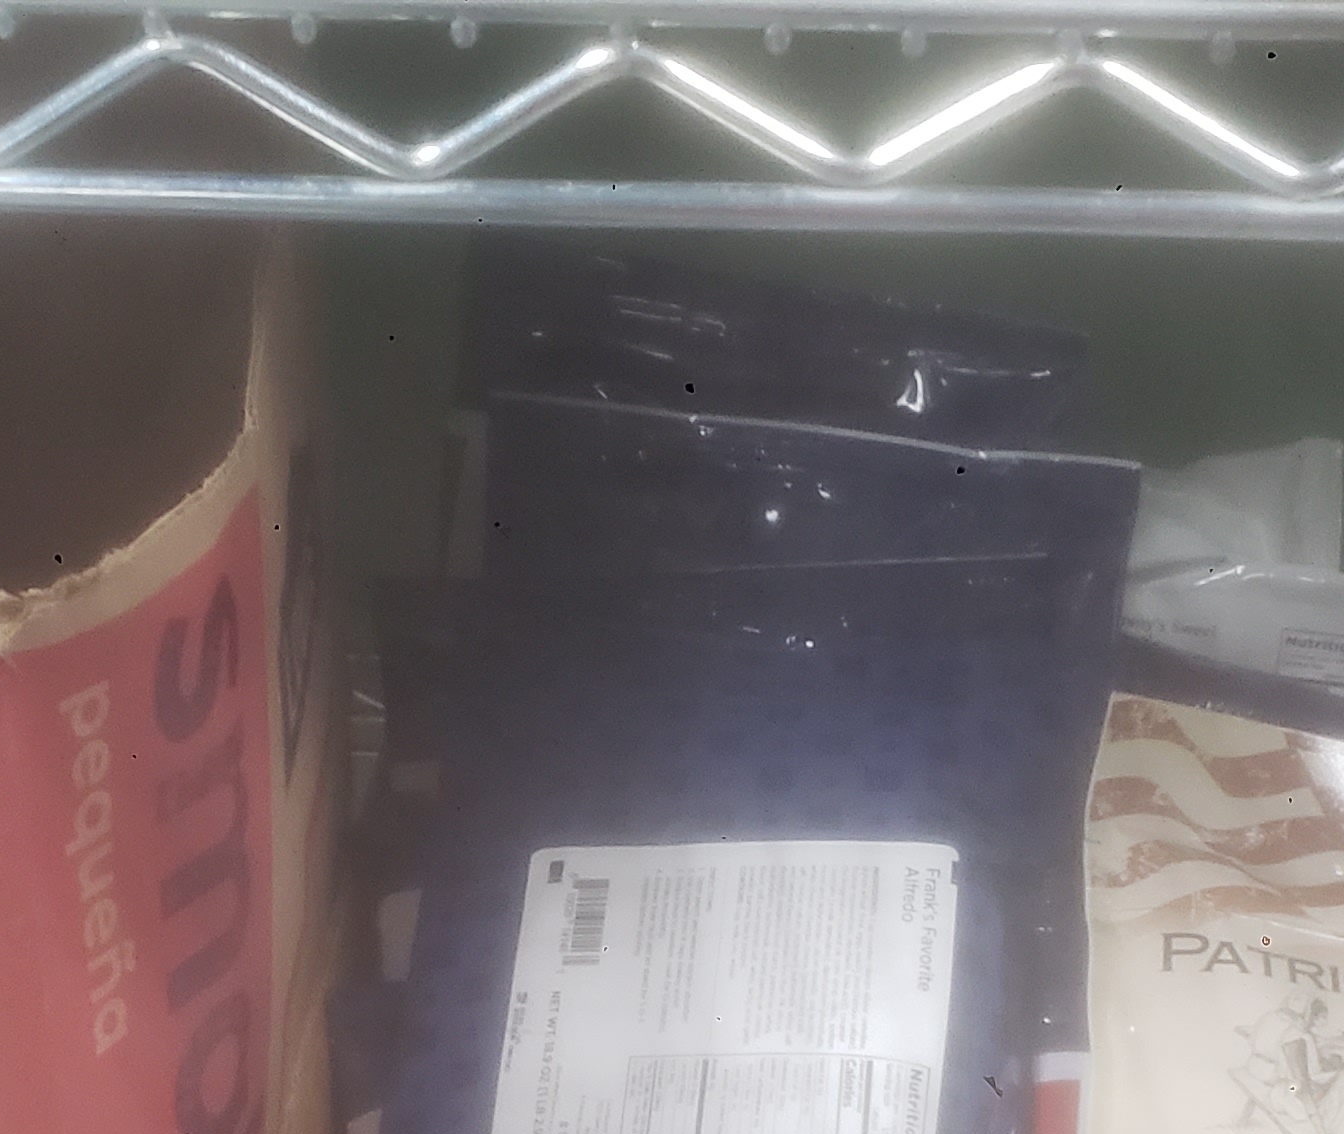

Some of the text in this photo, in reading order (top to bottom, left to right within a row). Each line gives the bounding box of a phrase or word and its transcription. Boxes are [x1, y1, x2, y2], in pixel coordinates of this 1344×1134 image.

[60, 680, 136, 1057] pequeña
[899, 866, 920, 923] Alfredo
[915, 867, 941, 993] Frank's Favorite
[549, 990, 561, 1013] NET
[841, 1058, 857, 1108] Calories
